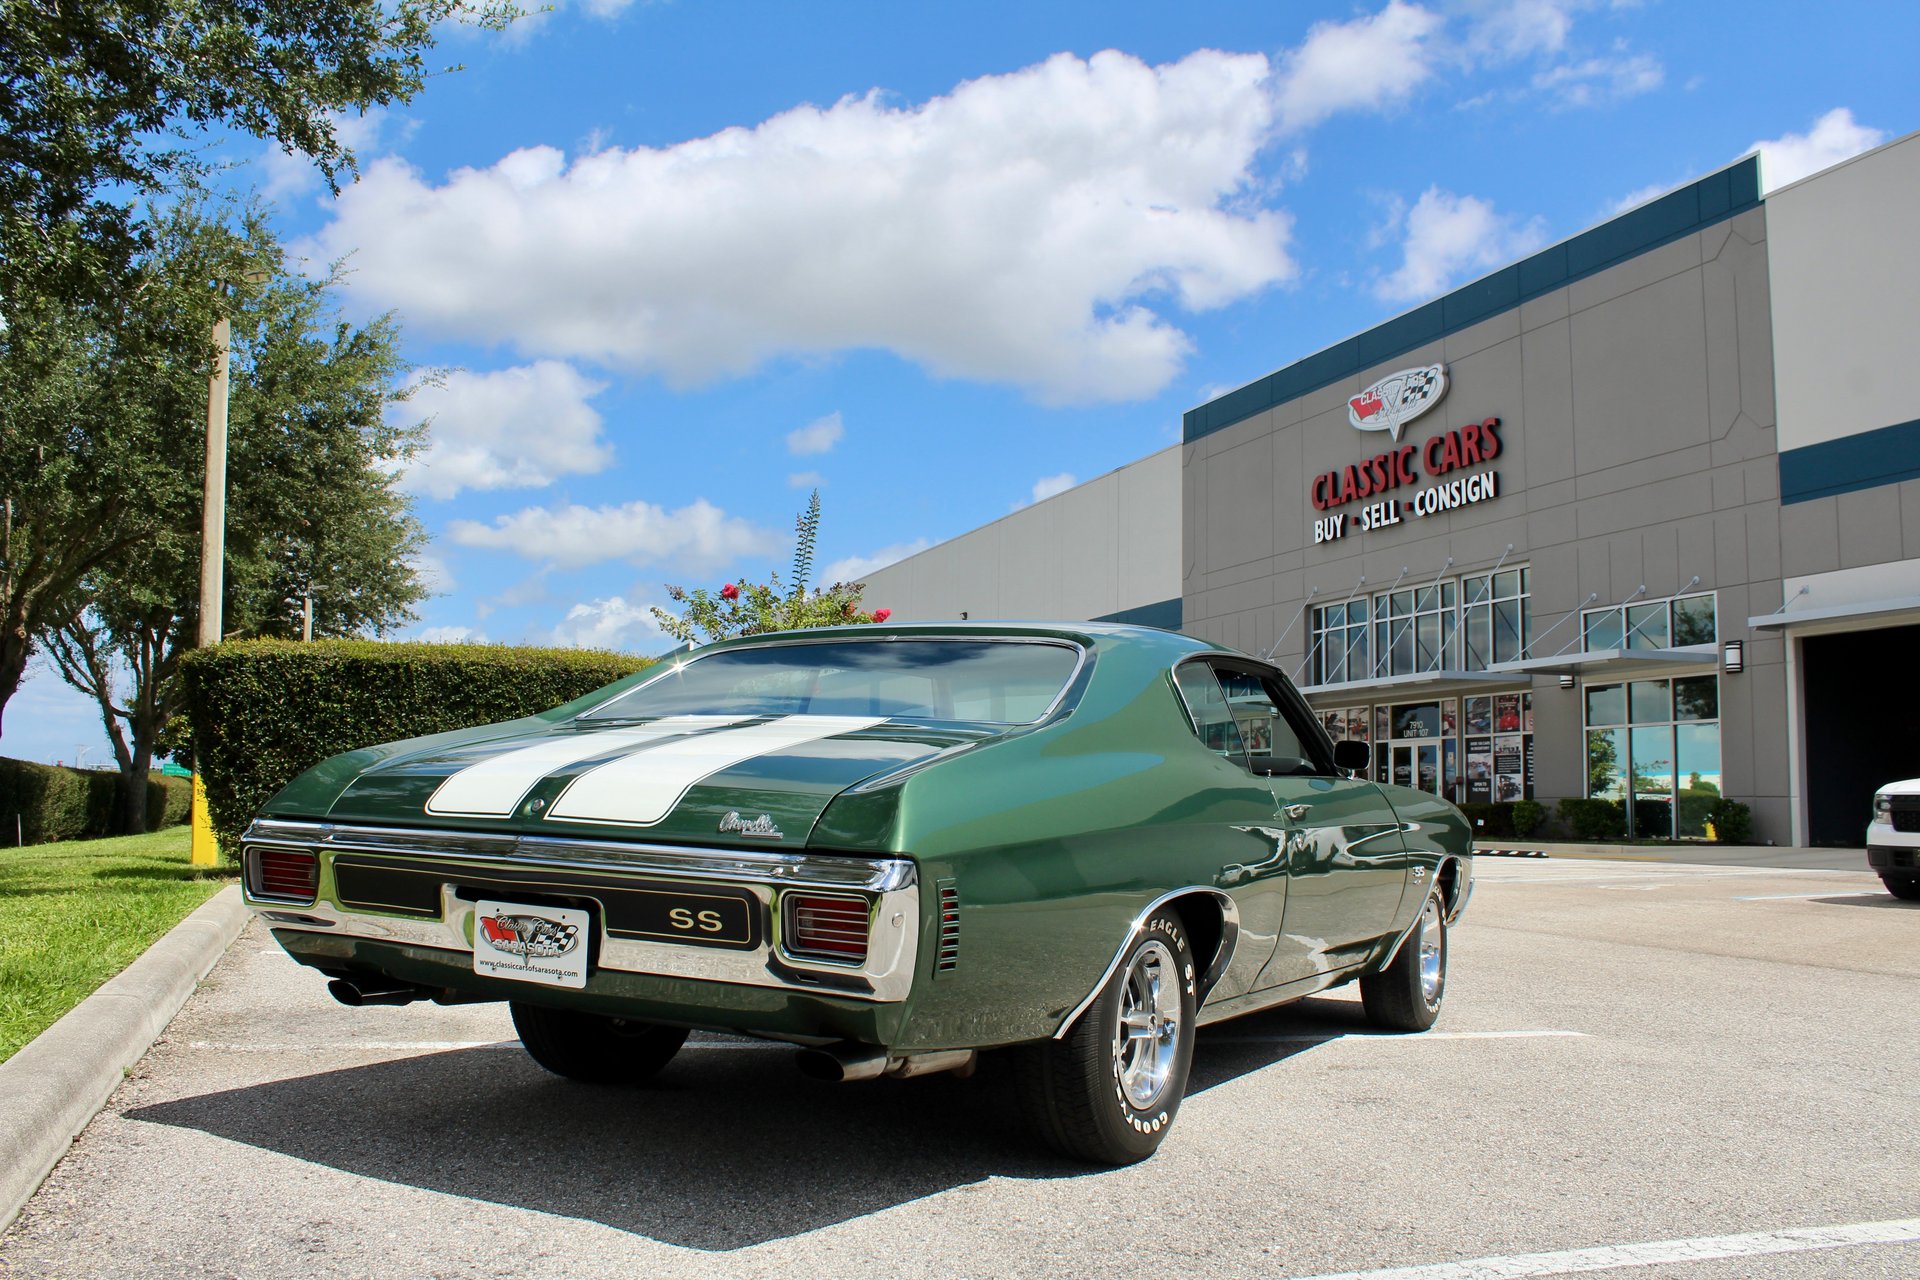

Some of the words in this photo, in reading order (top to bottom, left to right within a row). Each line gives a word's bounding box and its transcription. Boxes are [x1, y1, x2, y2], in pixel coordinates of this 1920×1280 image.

[1311, 445, 1416, 511] CLASSIC
[1423, 416, 1501, 476] CARS
[1314, 513, 1345, 544] BUY
[1362, 499, 1401, 531] SELL
[1414, 470, 1497, 517] CONSIGN
[1403, 730, 1417, 738] UNIT
[1409, 721, 1424, 729] 7910
[495, 913, 528, 932] Classic
[532, 917, 562, 936] Cars
[669, 908, 723, 932] SS
[1150, 918, 1186, 953] EAGLE
[494, 938, 561, 958] SARASOTA
[479, 959, 579, 978] www.classiccarsofsarasota.com
